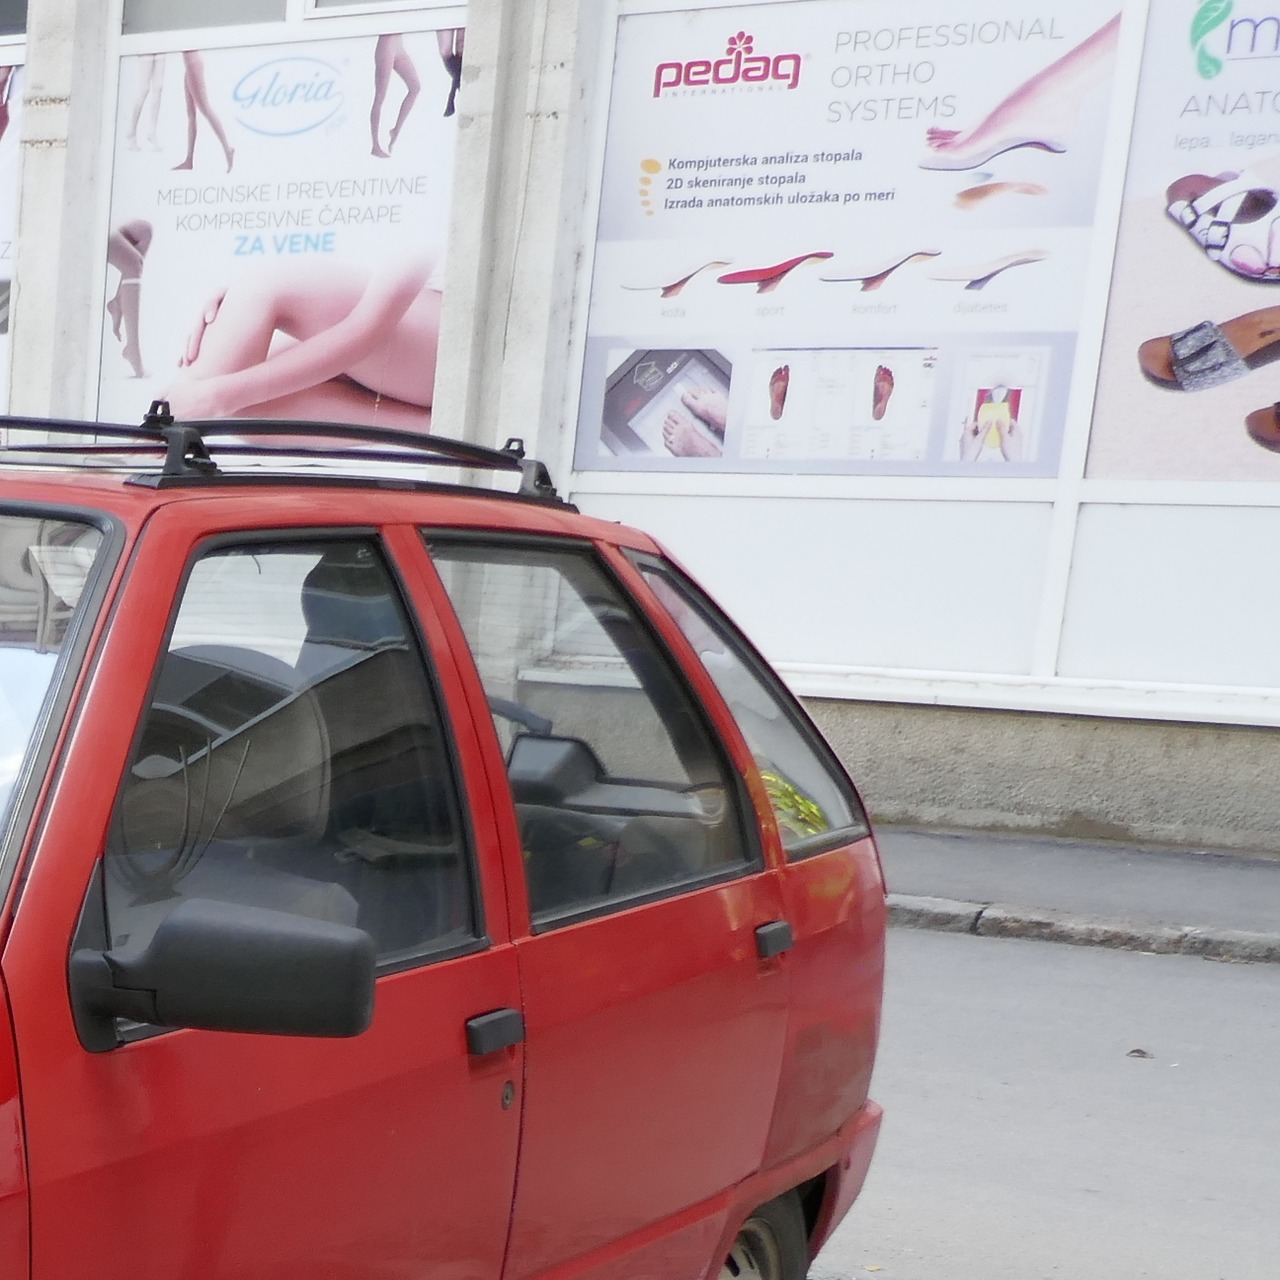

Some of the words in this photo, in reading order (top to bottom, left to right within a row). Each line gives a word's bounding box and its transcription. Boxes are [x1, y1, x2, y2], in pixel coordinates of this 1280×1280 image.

[834, 18, 1065, 53] PROFESSIONAL
[653, 43, 801, 98] pedag
[830, 61, 935, 88] ORTHO
[233, 71, 335, 110] Gloria
[826, 95, 957, 124] SYSTEMS
[668, 153, 757, 171] Kompjuterska
[761, 152, 809, 166] analiza
[813, 149, 862, 164] stopala
[157, 184, 271, 206] MEDICINSKE
[287, 177, 428, 200] PREVENTIVNE
[666, 178, 683, 190] 2D
[687, 174, 754, 189] skeniranje
[757, 172, 806, 187] stopala
[664, 195, 703, 210] Izrada
[707, 193, 783, 208] anatomskih
[787, 190, 839, 205] uložaka
[843, 193, 860, 205] po
[865, 188, 896, 202] meri
[176, 209, 312, 232] KOMPRESIVNE
[318, 205, 402, 227] ČARAPE
[234, 235, 265, 256] ZA
[273, 232, 335, 253] VENE
